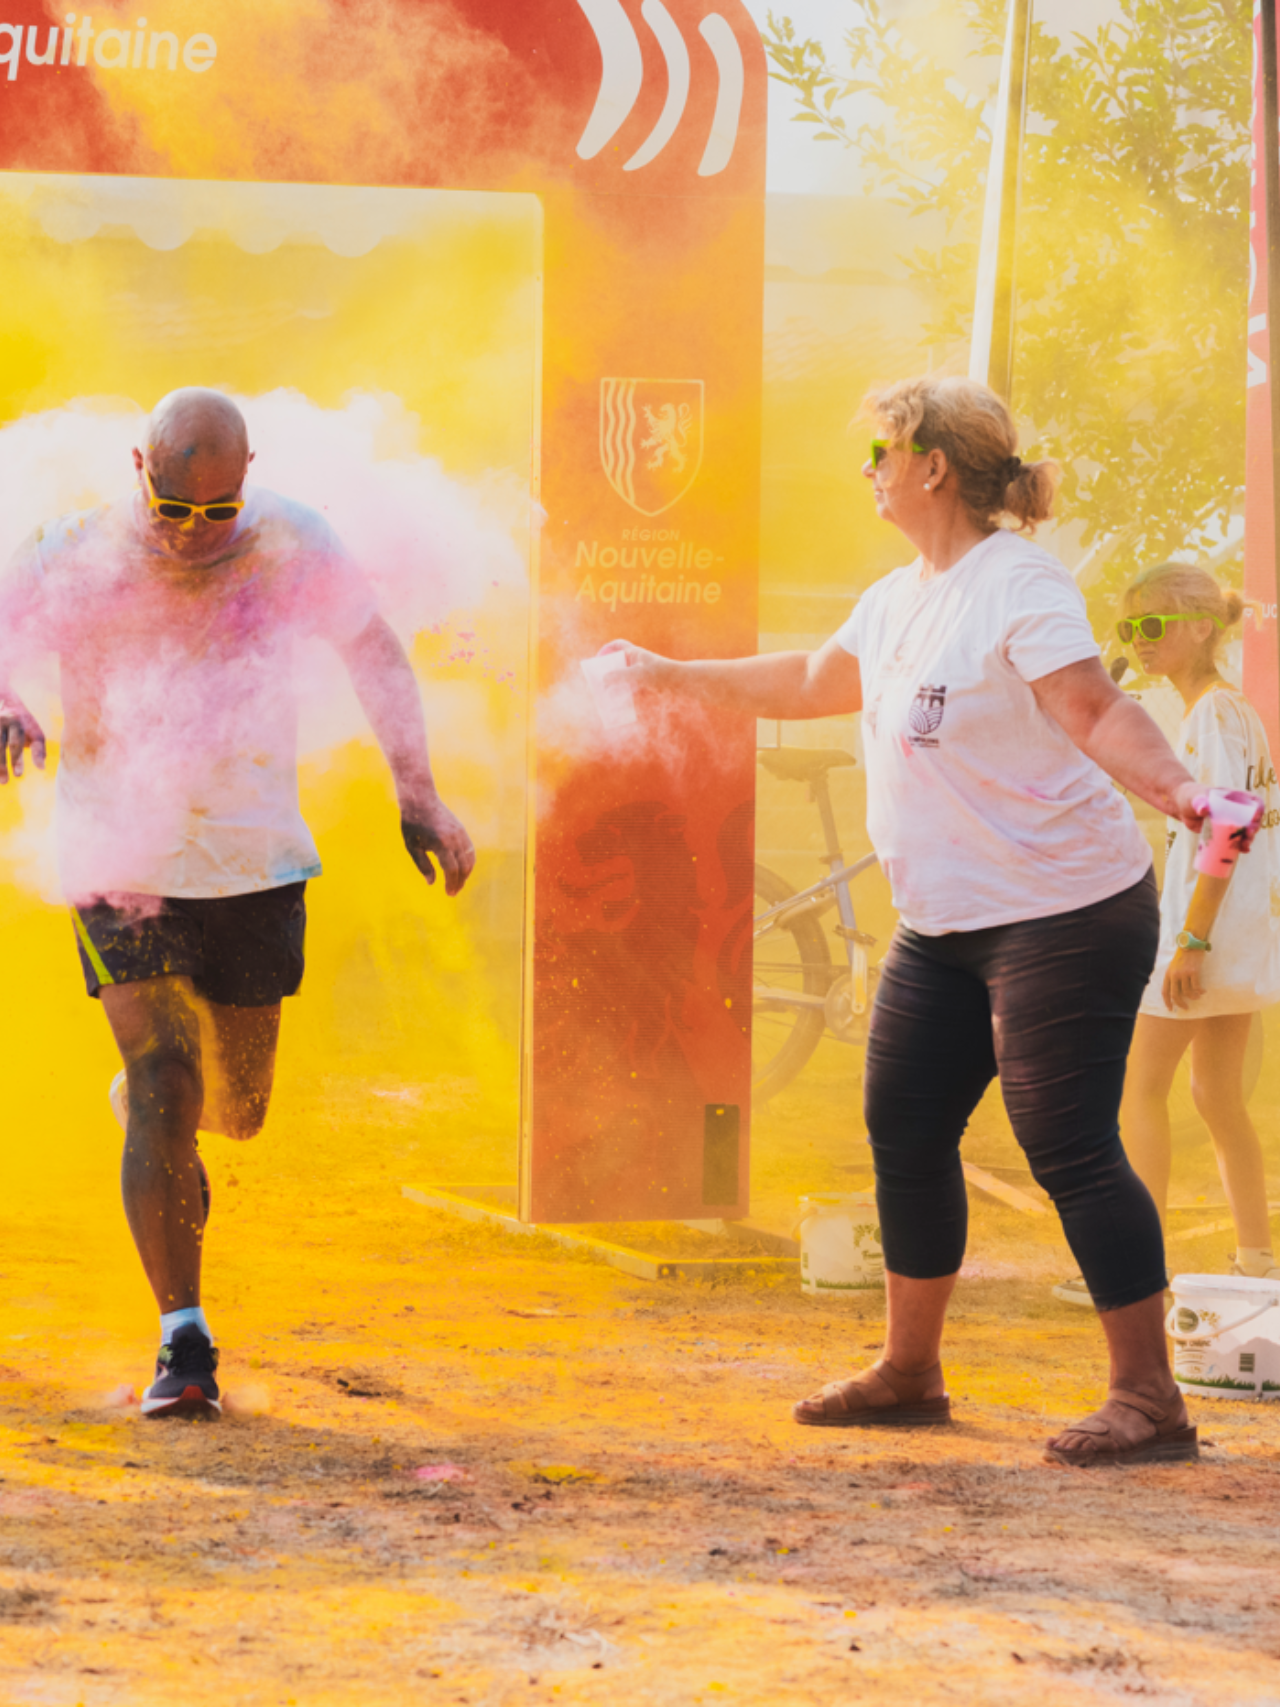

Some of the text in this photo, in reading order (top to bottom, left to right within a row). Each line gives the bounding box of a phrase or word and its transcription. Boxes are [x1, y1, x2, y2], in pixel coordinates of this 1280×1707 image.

[622, 526, 681, 541] RÉGION
[574, 540, 725, 570] Nouvelle-
[574, 574, 722, 612] Aquitaine
